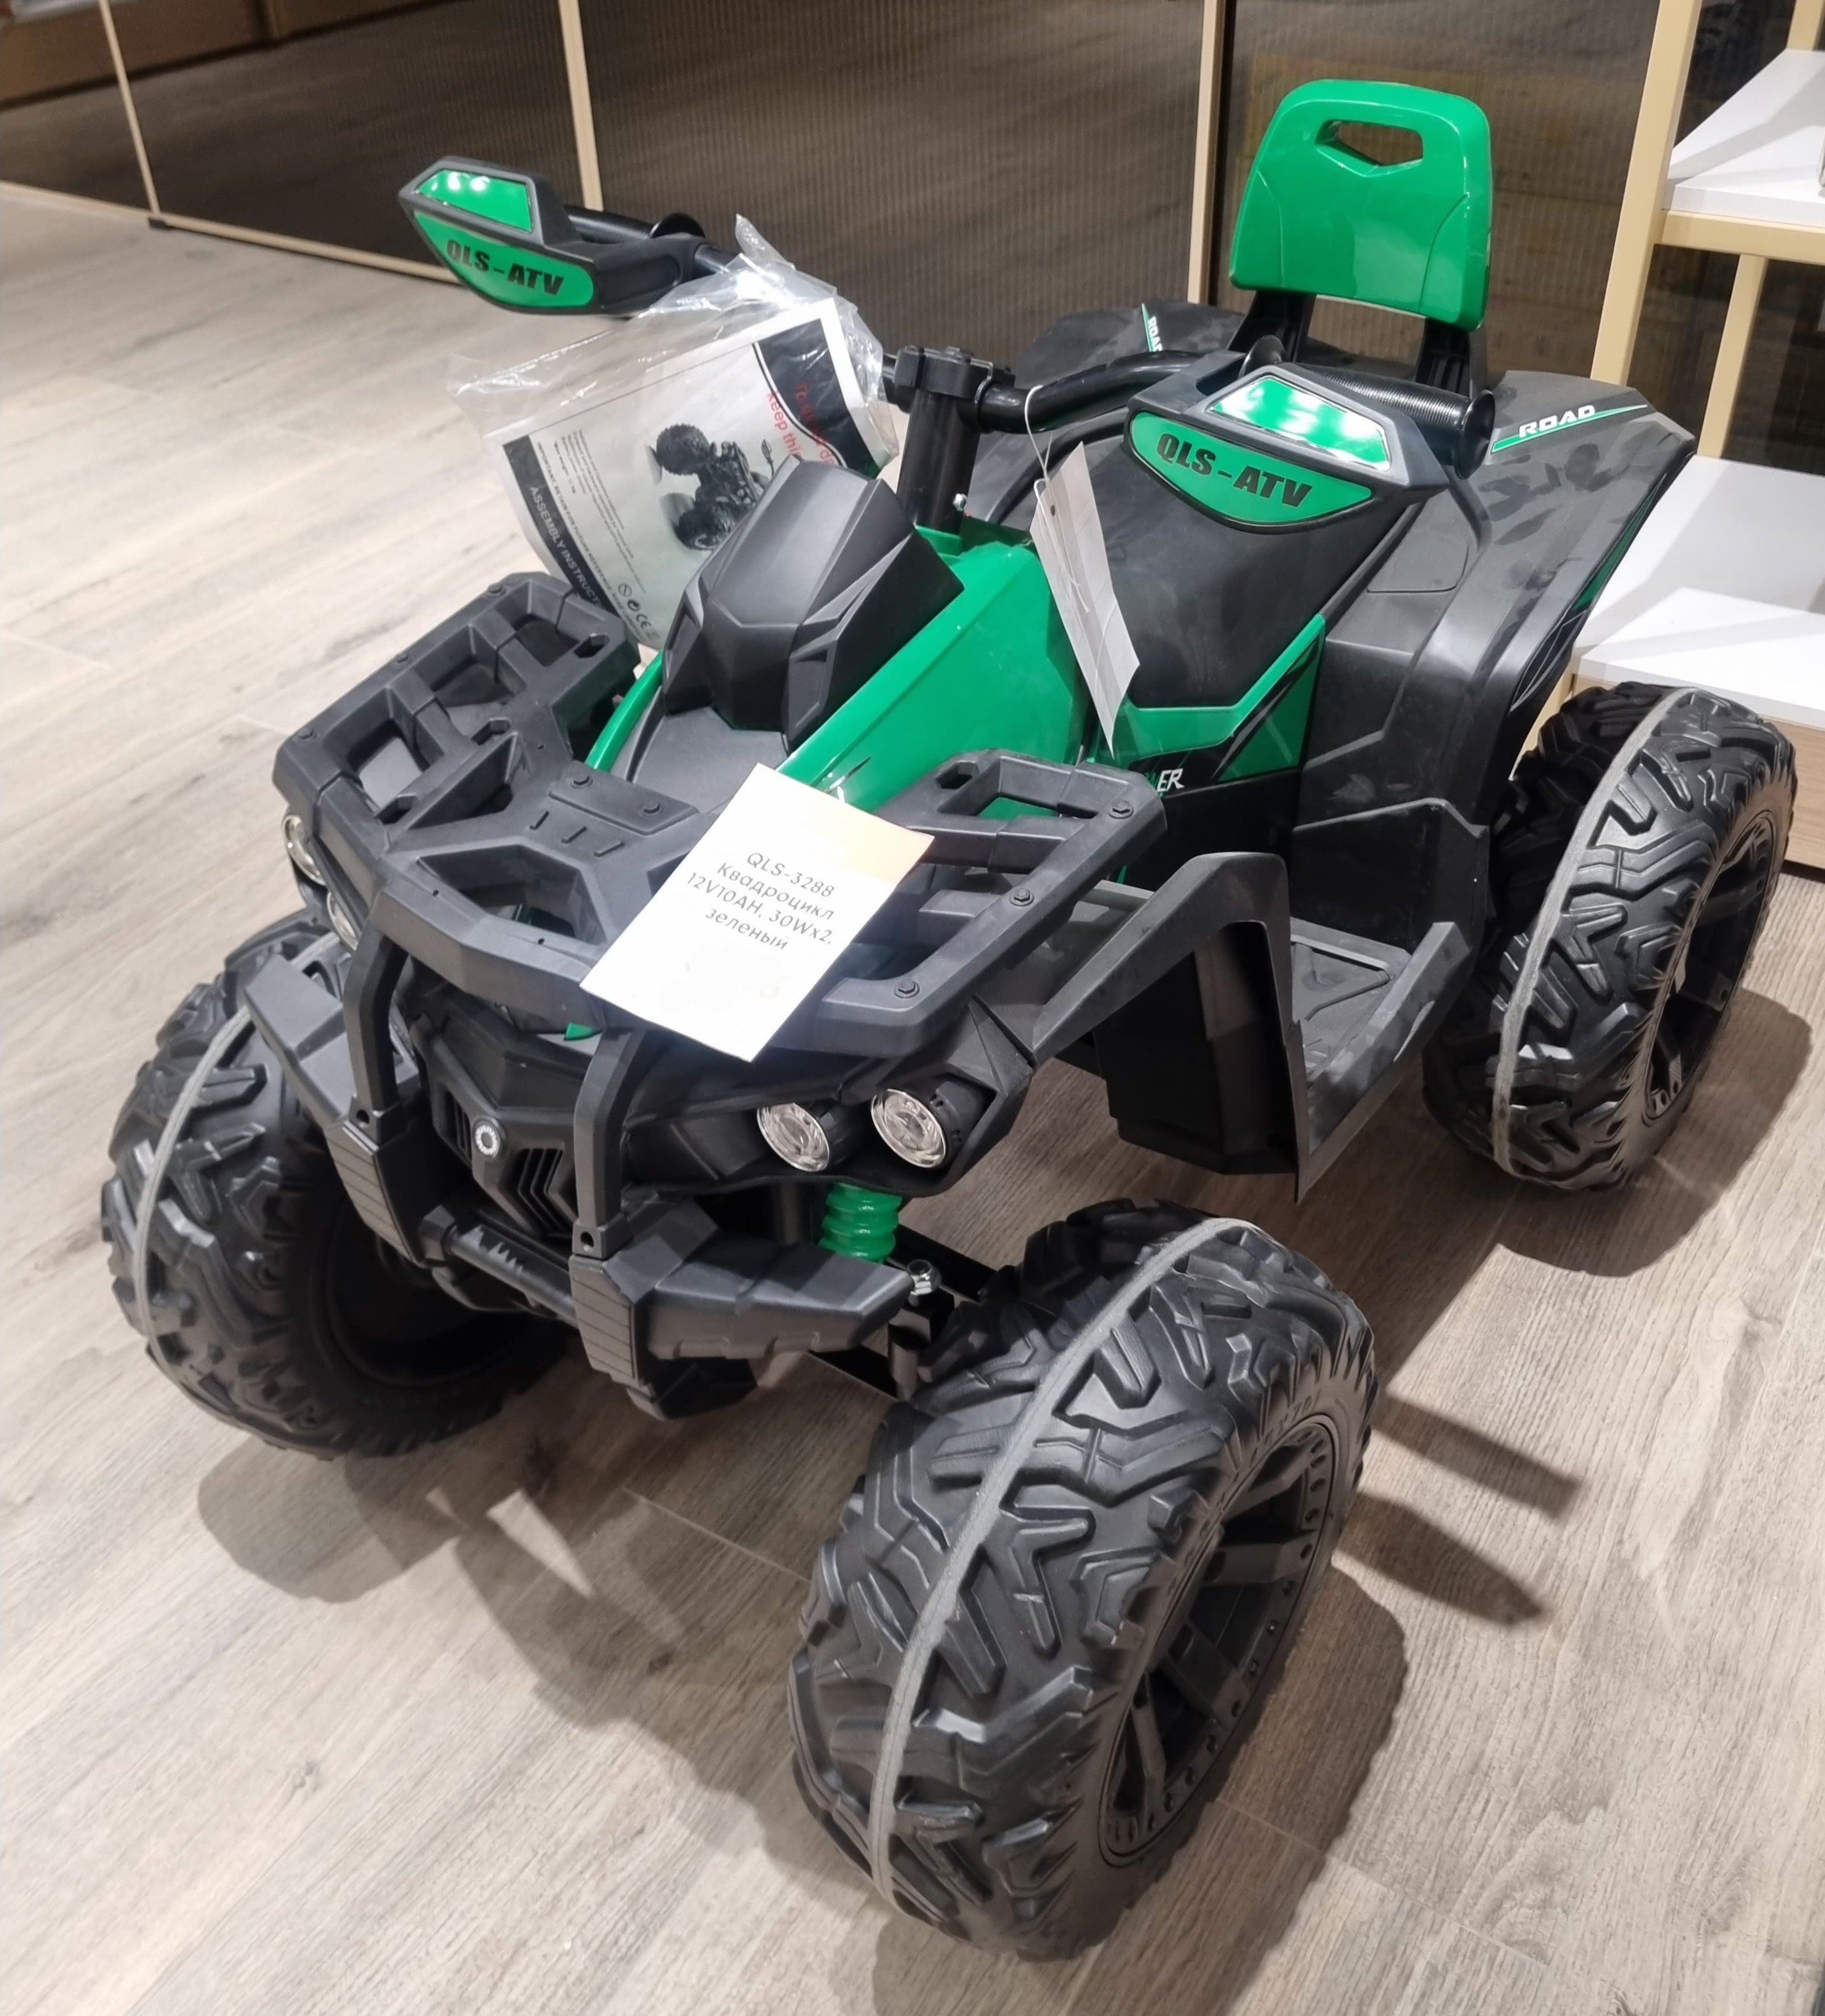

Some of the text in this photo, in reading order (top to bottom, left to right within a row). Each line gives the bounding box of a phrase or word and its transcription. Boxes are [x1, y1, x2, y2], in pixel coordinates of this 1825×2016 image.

[447, 240, 564, 296] QLS-ATV
[1518, 404, 1595, 438] ROAD
[1157, 433, 1313, 508] QLS-ATV
[530, 486, 566, 549] ASSEMBLY
[560, 550, 600, 605] INSTRUCT
[717, 862, 834, 920] Квадроцикл
[747, 853, 835, 897] QLS-3288
[705, 908, 789, 950] зеленый
